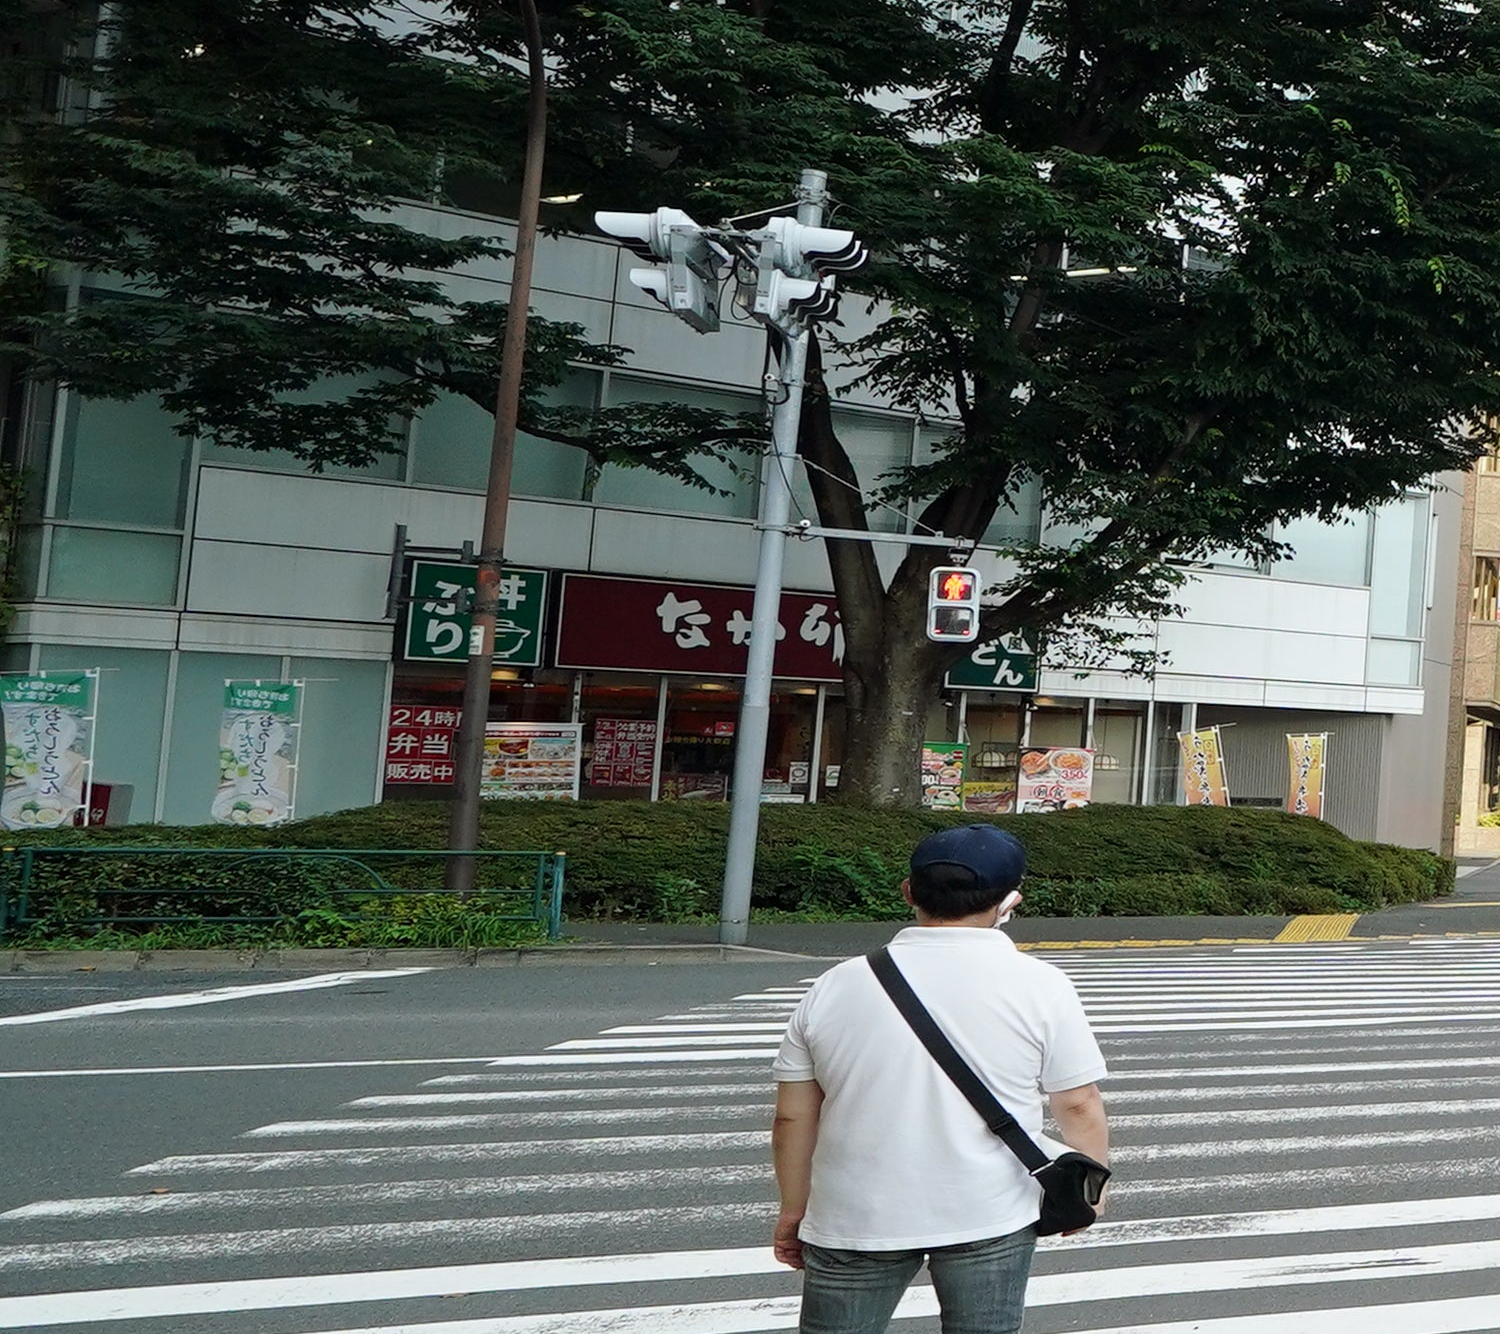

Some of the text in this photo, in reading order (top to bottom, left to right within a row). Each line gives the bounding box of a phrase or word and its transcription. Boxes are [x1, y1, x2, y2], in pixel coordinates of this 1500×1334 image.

[388, 732, 450, 755] 弁当
[386, 763, 454, 780] 販売中
